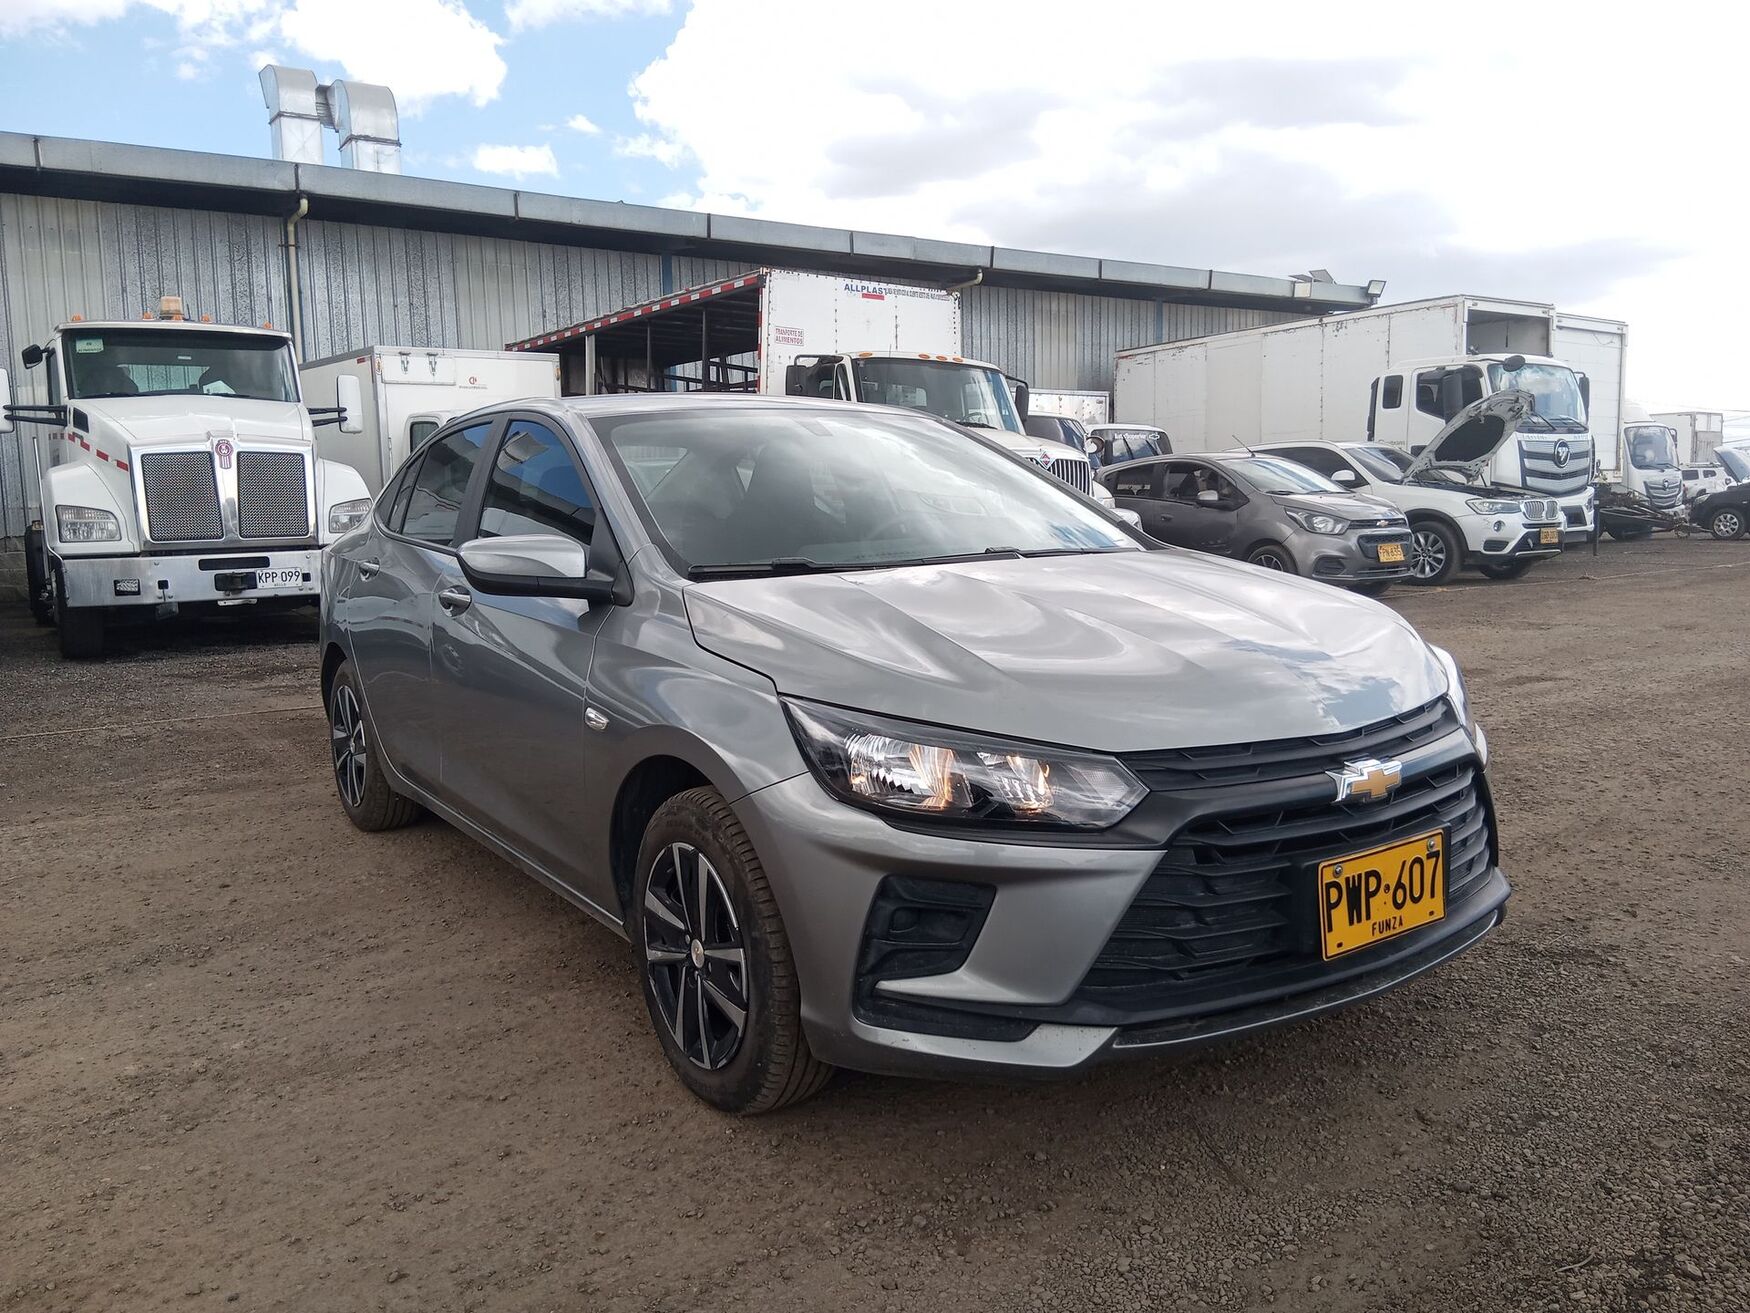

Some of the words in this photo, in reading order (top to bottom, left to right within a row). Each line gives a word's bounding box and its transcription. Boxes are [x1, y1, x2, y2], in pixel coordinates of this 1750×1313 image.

[257, 571, 278, 583] KPP
[280, 570, 301, 582] 099
[1371, 915, 1404, 937] FUNZA
